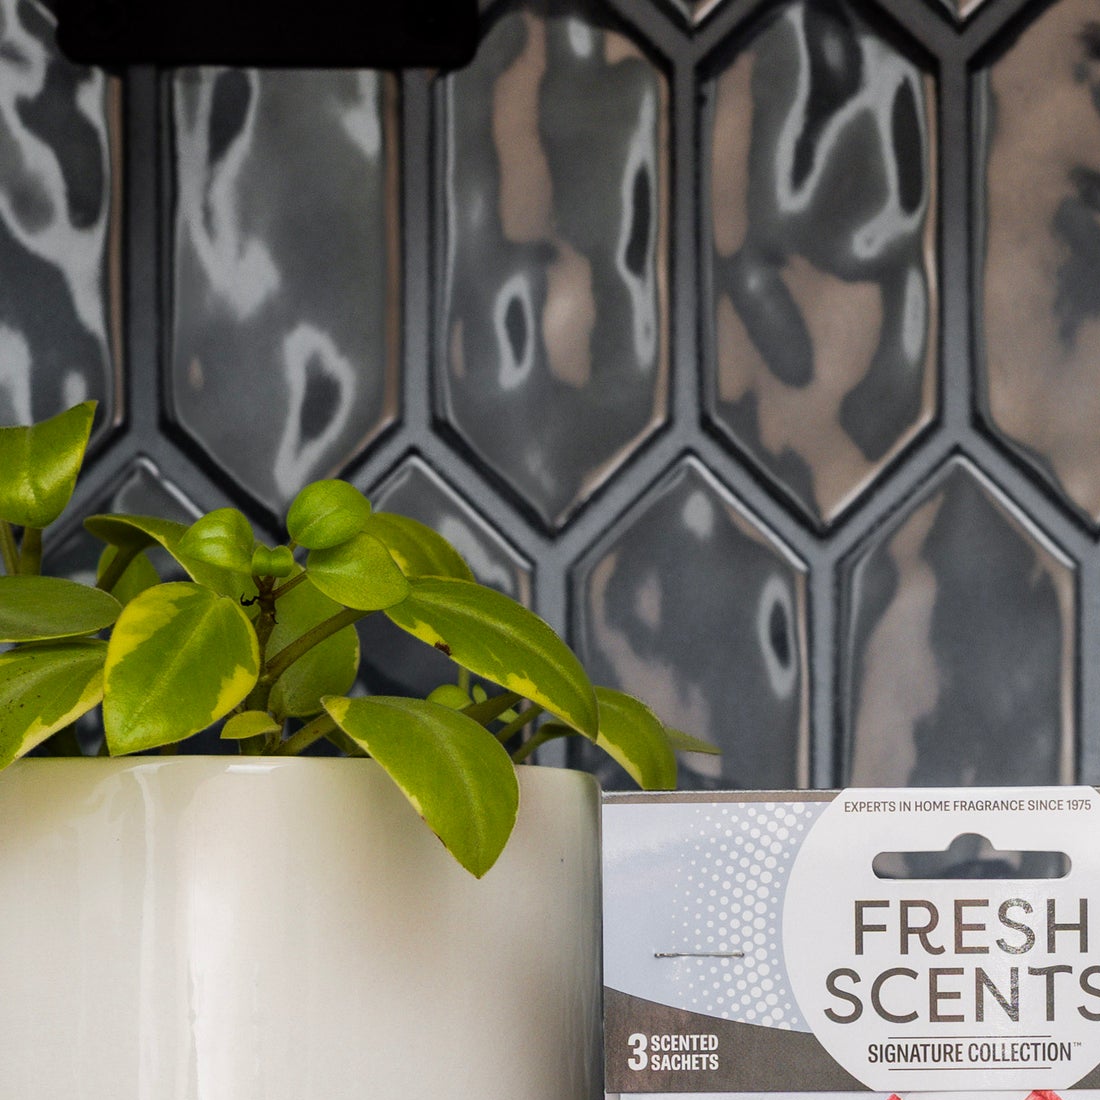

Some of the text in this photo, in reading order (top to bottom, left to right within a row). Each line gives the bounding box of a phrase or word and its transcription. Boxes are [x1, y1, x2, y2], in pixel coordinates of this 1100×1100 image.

[844, 799, 1092, 813] EXPERTS IN HOME FRAGRANCE SINCE 1975
[854, 897, 1089, 956] FRESH
[627, 1033, 719, 1071] 3 SCENTED
[650, 1054, 719, 1071] SACHETS
[867, 1042, 964, 1064] SIGNATURE
